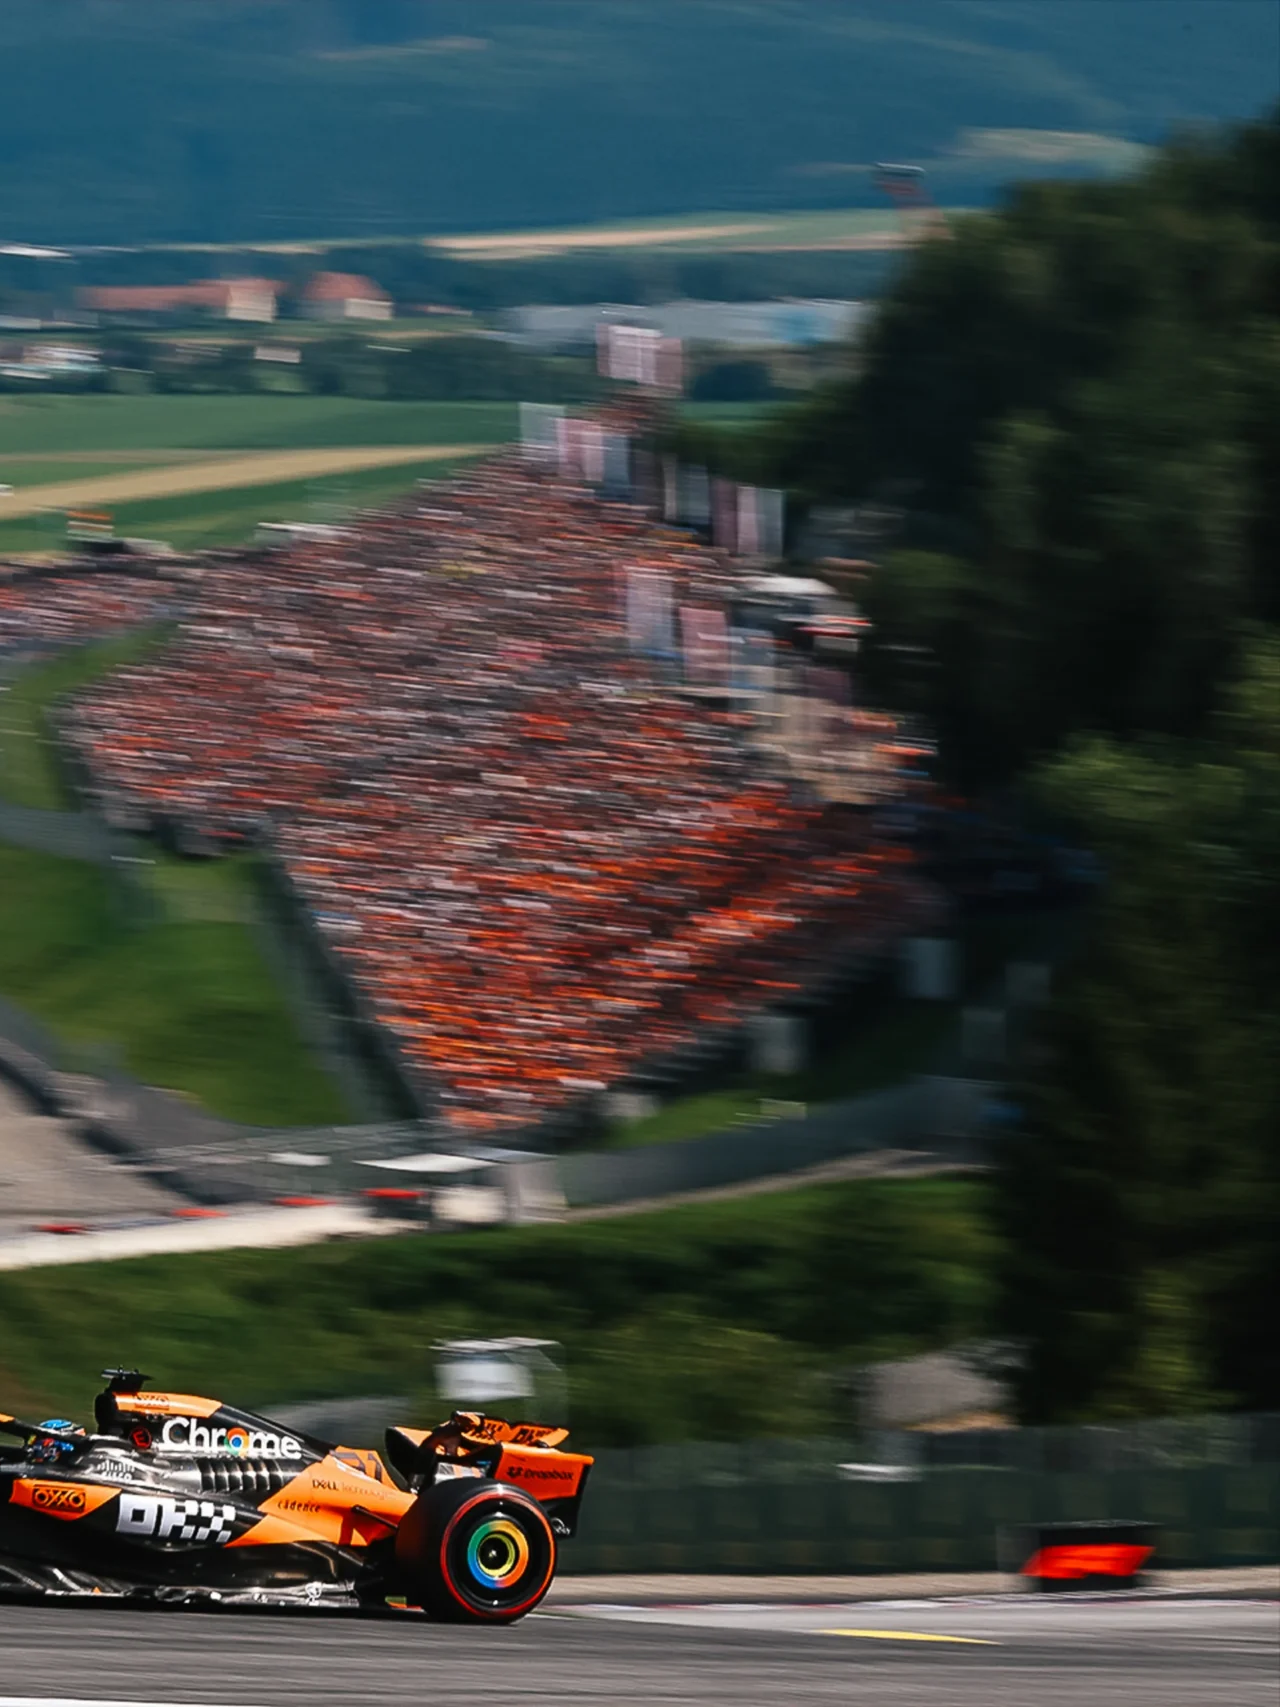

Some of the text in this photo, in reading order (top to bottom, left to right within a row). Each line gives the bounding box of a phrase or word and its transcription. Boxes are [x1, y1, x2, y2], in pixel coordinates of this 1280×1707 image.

[162, 1416, 302, 1459] Chrome
[34, 1487, 86, 1508] OXXO
[116, 1493, 236, 1542] OKX
